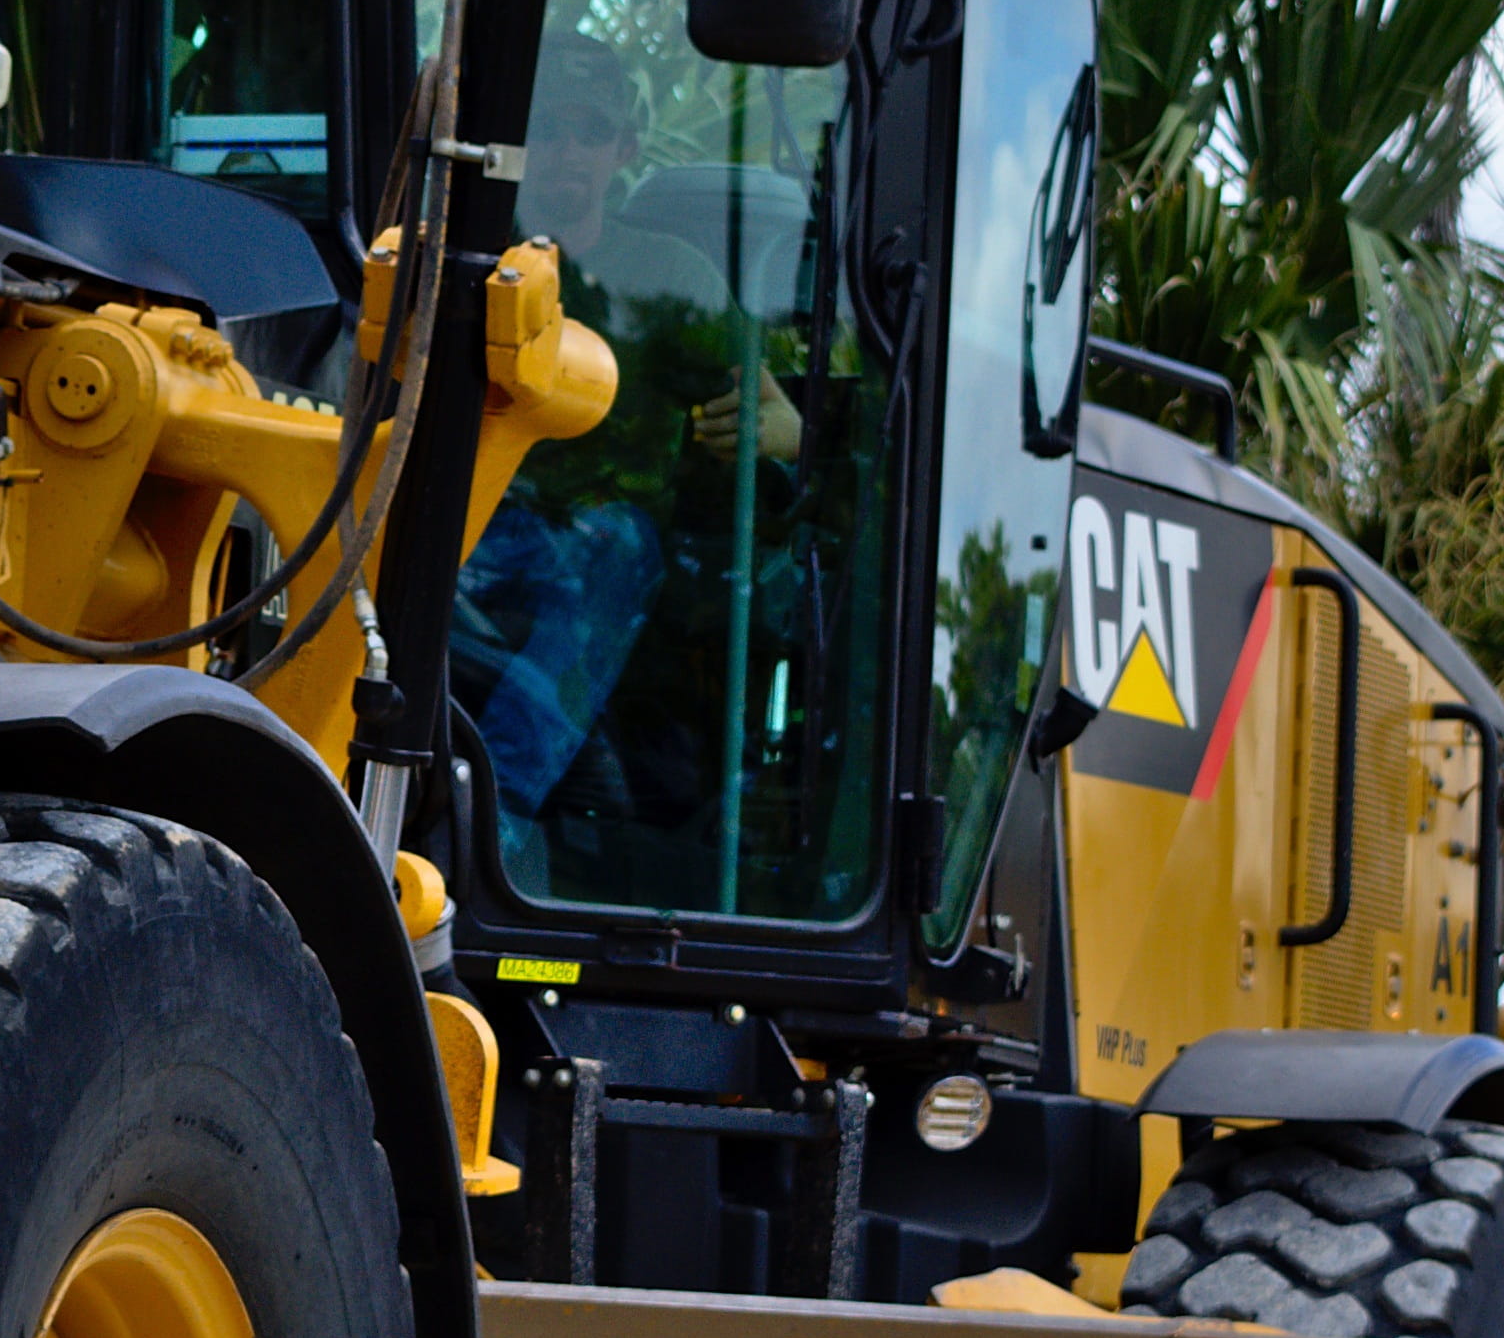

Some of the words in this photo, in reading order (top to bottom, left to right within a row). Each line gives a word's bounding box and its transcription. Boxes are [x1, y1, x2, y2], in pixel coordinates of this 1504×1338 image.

[1069, 494, 1199, 729] CAT
[503, 961, 574, 980] MA24386
[1096, 1024, 1120, 1061] VHP
